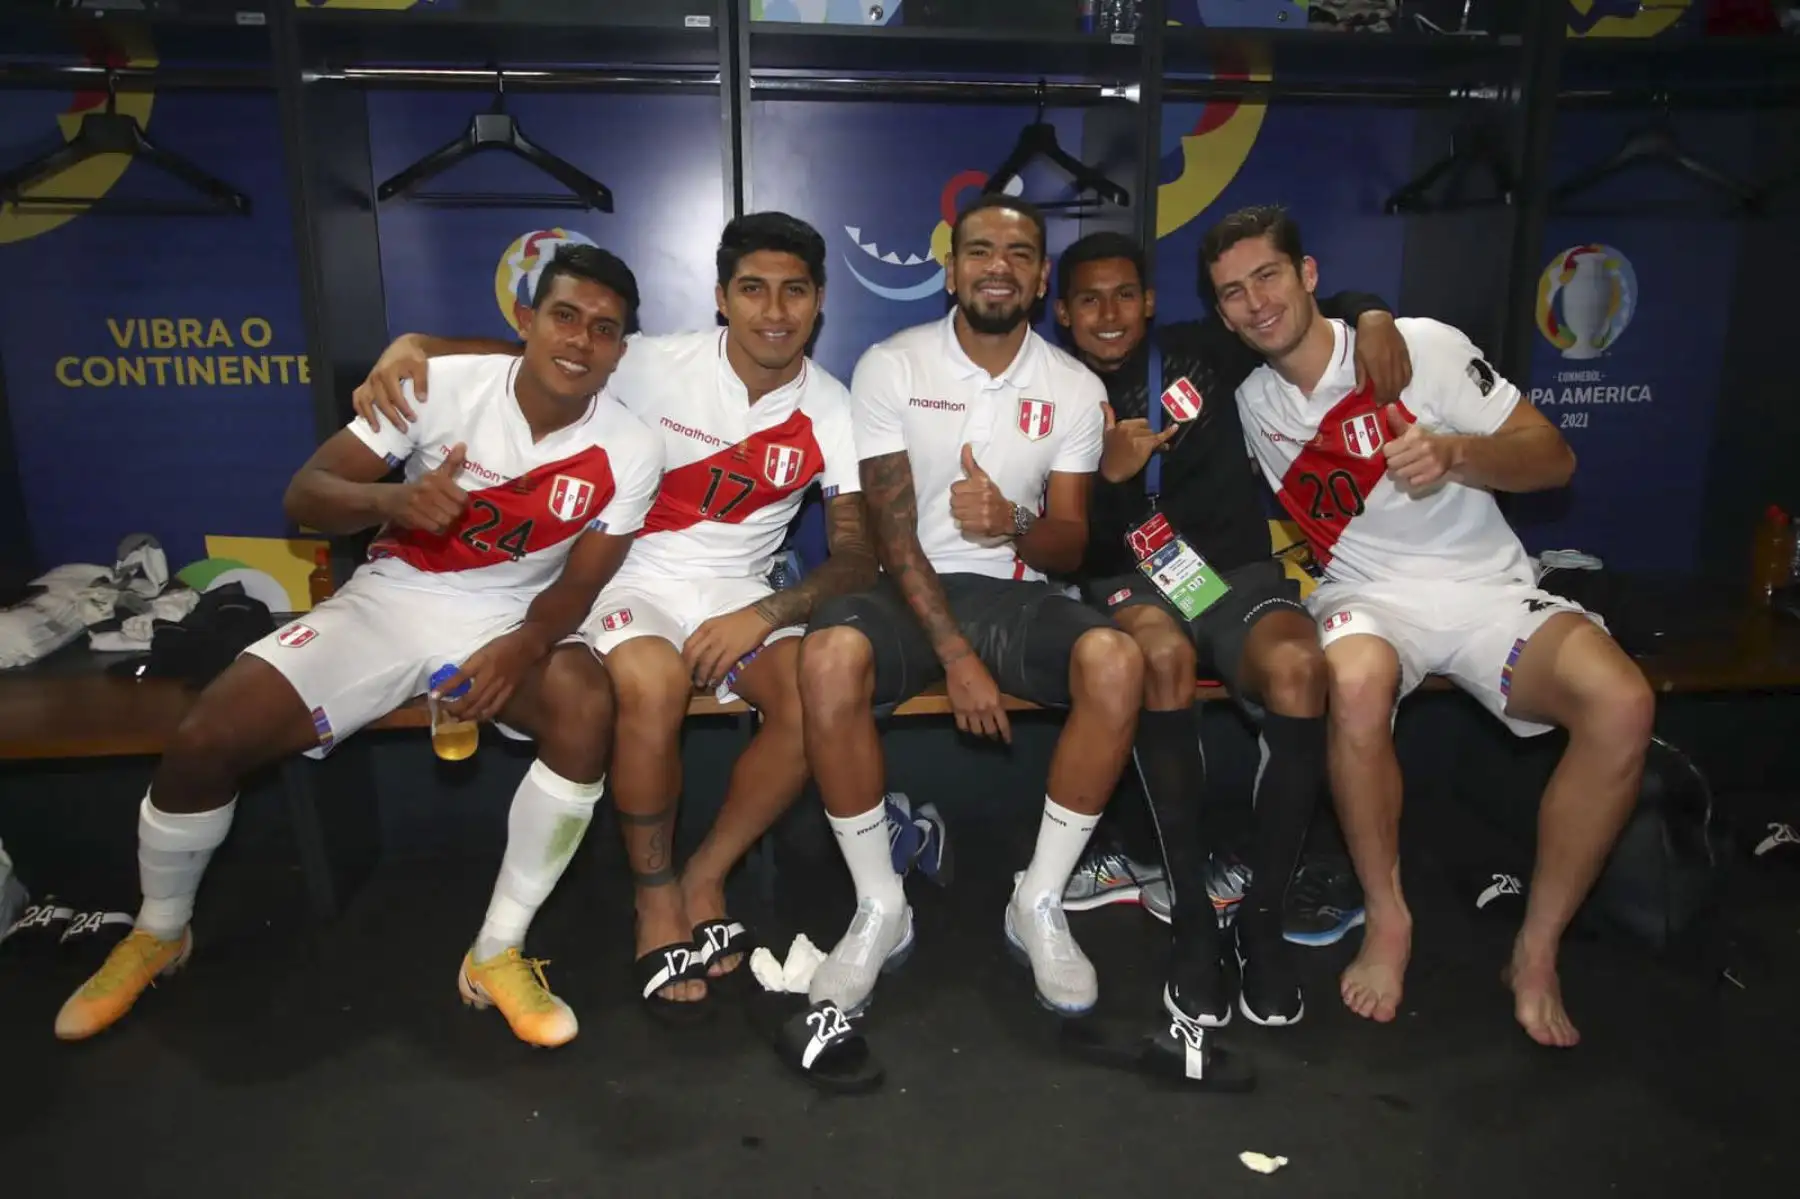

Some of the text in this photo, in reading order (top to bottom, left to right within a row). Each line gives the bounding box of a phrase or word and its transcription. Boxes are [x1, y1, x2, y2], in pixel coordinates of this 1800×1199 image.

[107, 317, 272, 349] VIBRA O
[55, 354, 311, 387] CONTINENTE
[909, 396, 966, 412] marathon
[1556, 384, 1652, 405] AMERICA
[659, 416, 721, 447] marathon
[1560, 411, 1589, 428] 2021
[699, 465, 757, 521] 17
[1299, 469, 1365, 519] 20
[460, 500, 534, 561] 24
[18, 905, 55, 927] 24
[69, 911, 103, 935] 24
[704, 924, 730, 950] 17
[664, 948, 690, 977] 17
[806, 1006, 852, 1043] 22
